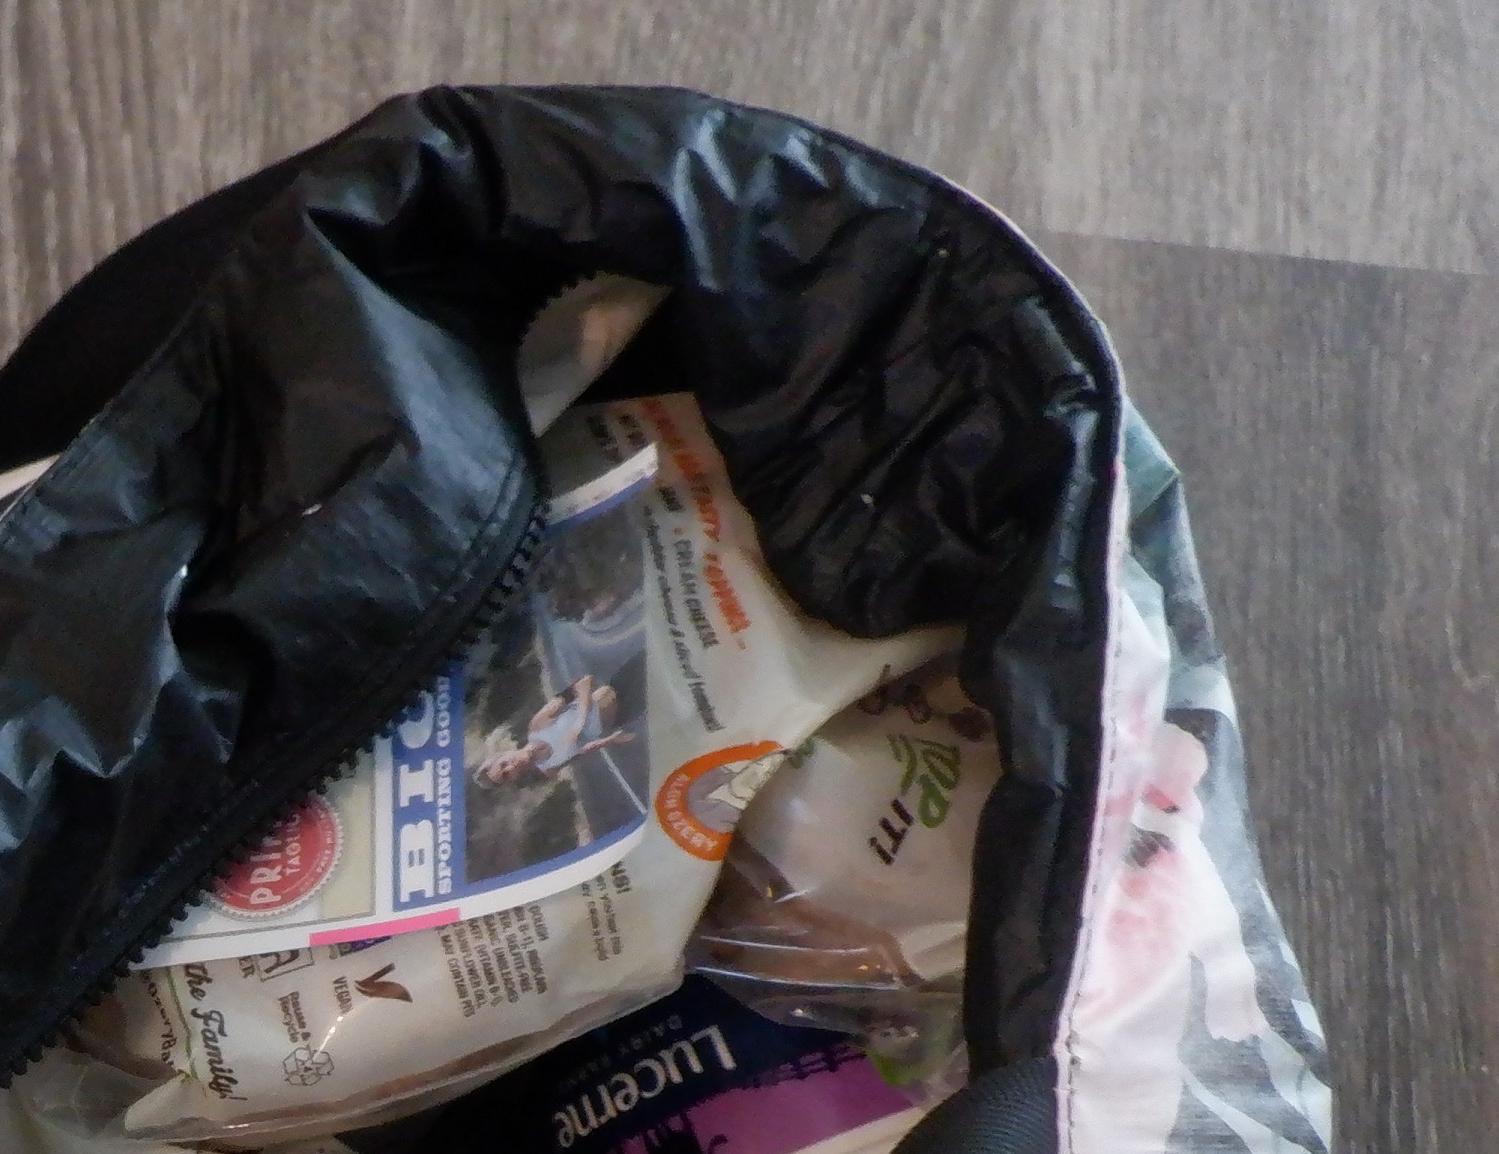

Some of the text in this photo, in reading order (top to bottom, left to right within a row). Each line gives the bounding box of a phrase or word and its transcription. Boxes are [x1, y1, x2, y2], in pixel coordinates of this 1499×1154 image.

[435, 757, 455, 897] SPORTING
[867, 799, 915, 867] IT!
[333, 976, 354, 1015] VEGAN
[191, 1007, 248, 1101] Family!
[552, 1024, 738, 1149] Lucerne
